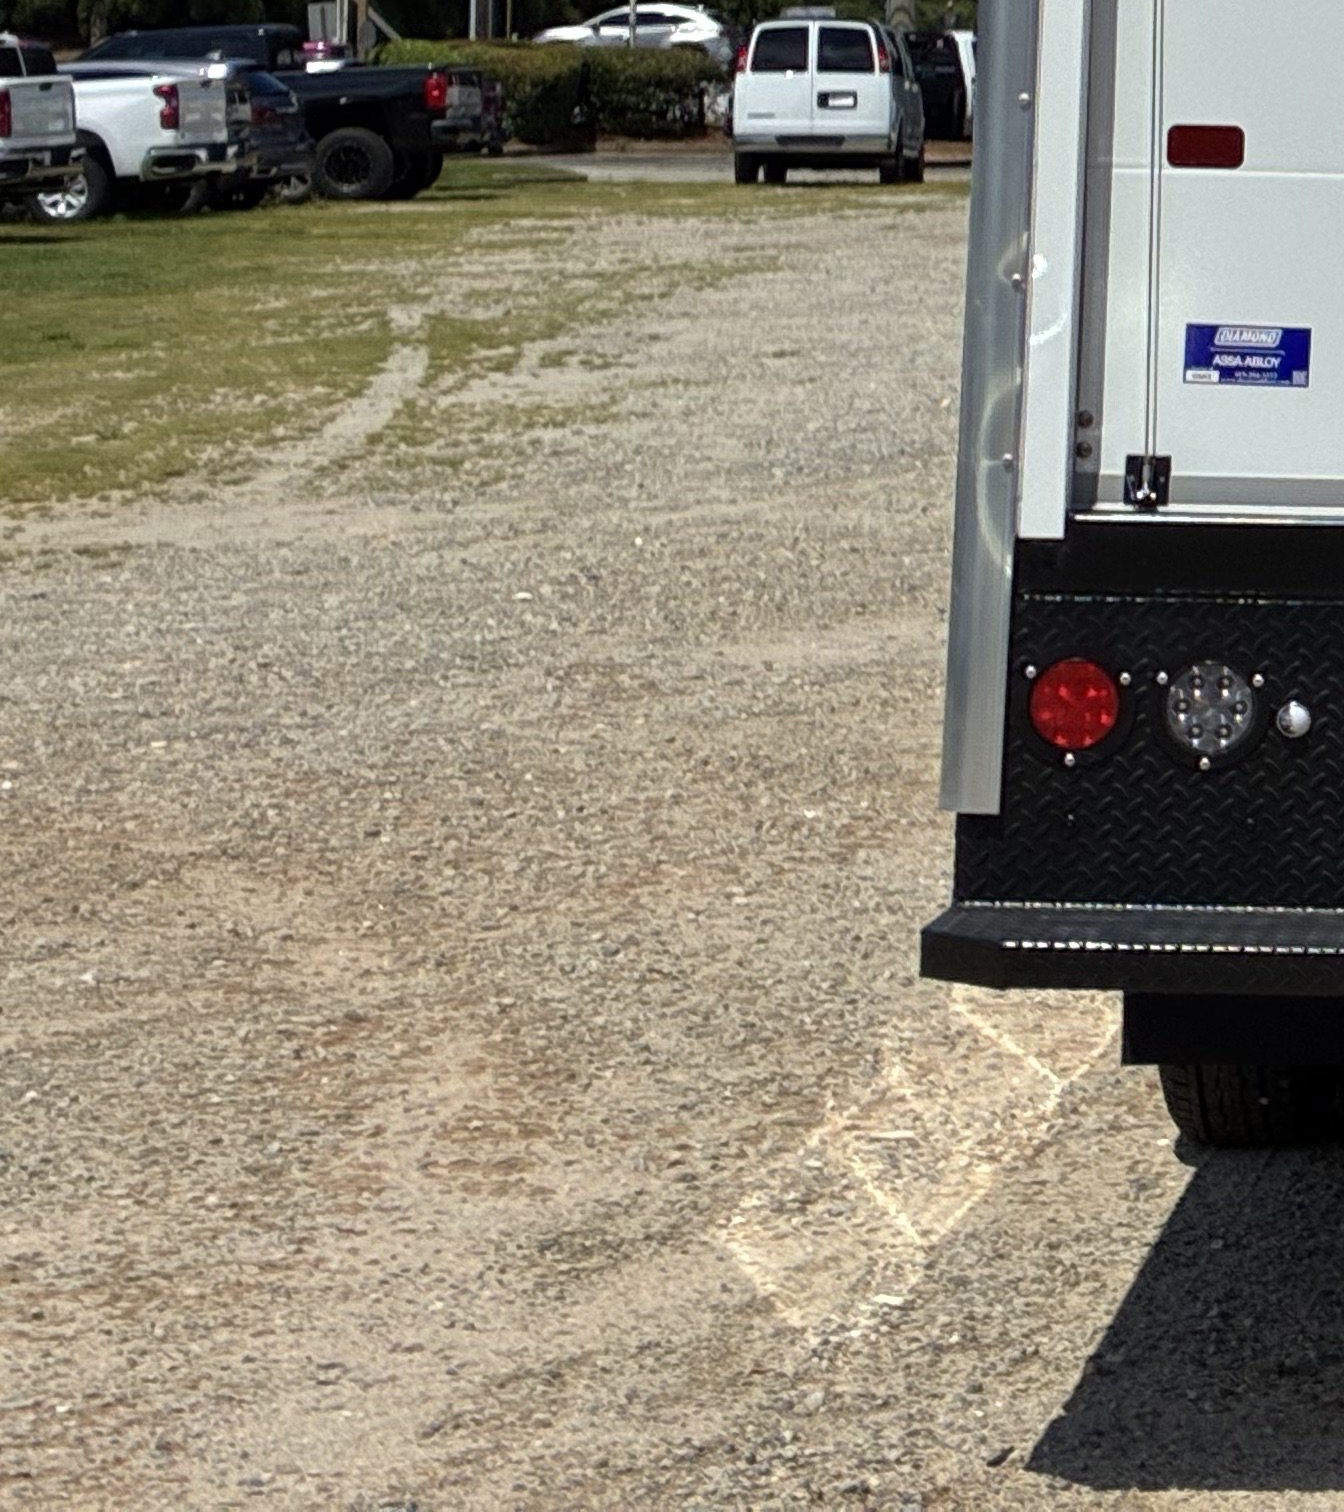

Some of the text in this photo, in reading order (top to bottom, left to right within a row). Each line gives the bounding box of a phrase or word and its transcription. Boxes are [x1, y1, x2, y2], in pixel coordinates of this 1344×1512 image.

[1220, 329, 1276, 343] DIAMOND
[1213, 354, 1282, 368] ASSA ABLOY
